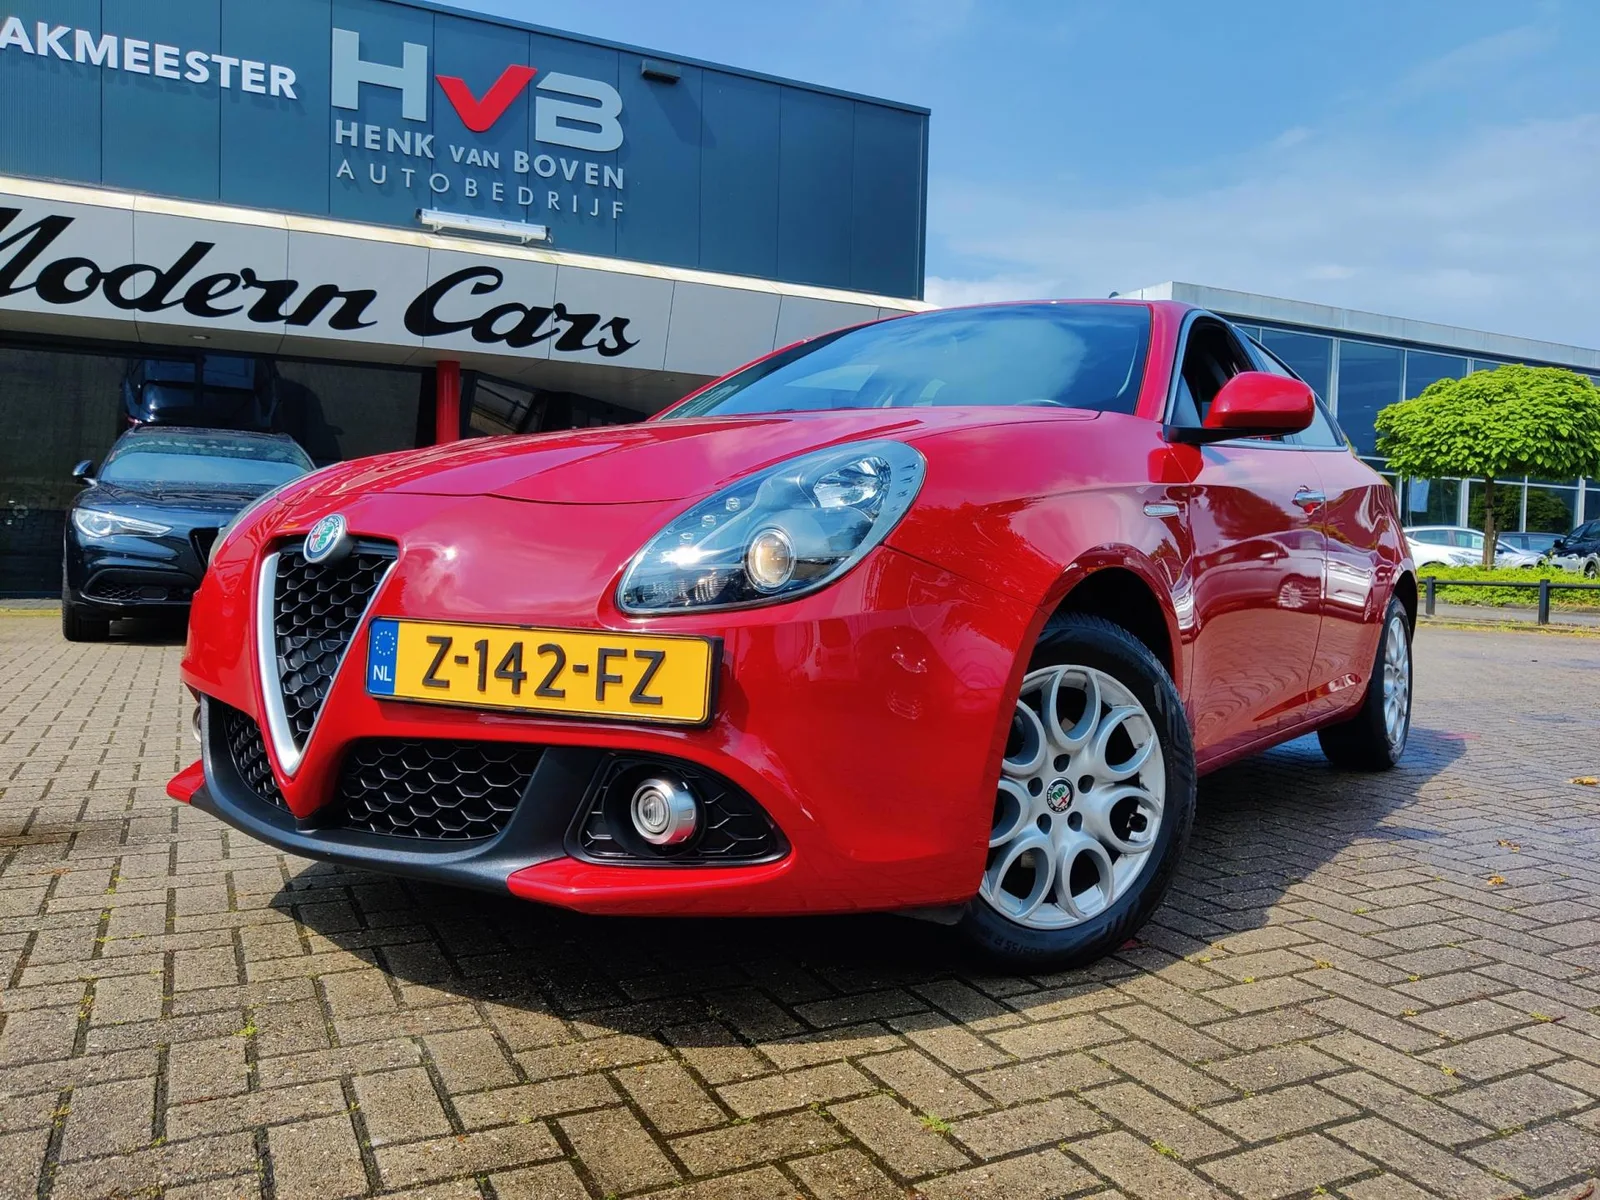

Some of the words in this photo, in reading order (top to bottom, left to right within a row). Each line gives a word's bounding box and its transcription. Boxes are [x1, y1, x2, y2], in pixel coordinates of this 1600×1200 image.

[335, 119, 435, 159] HENK
[449, 144, 500, 170] VAN
[513, 150, 624, 190] BOVEN
[336, 159, 624, 219] AUTOBEDRIJF
[404, 265, 641, 357] Cars
[373, 665, 392, 682] NL
[421, 635, 666, 705] Z-142-FZ
